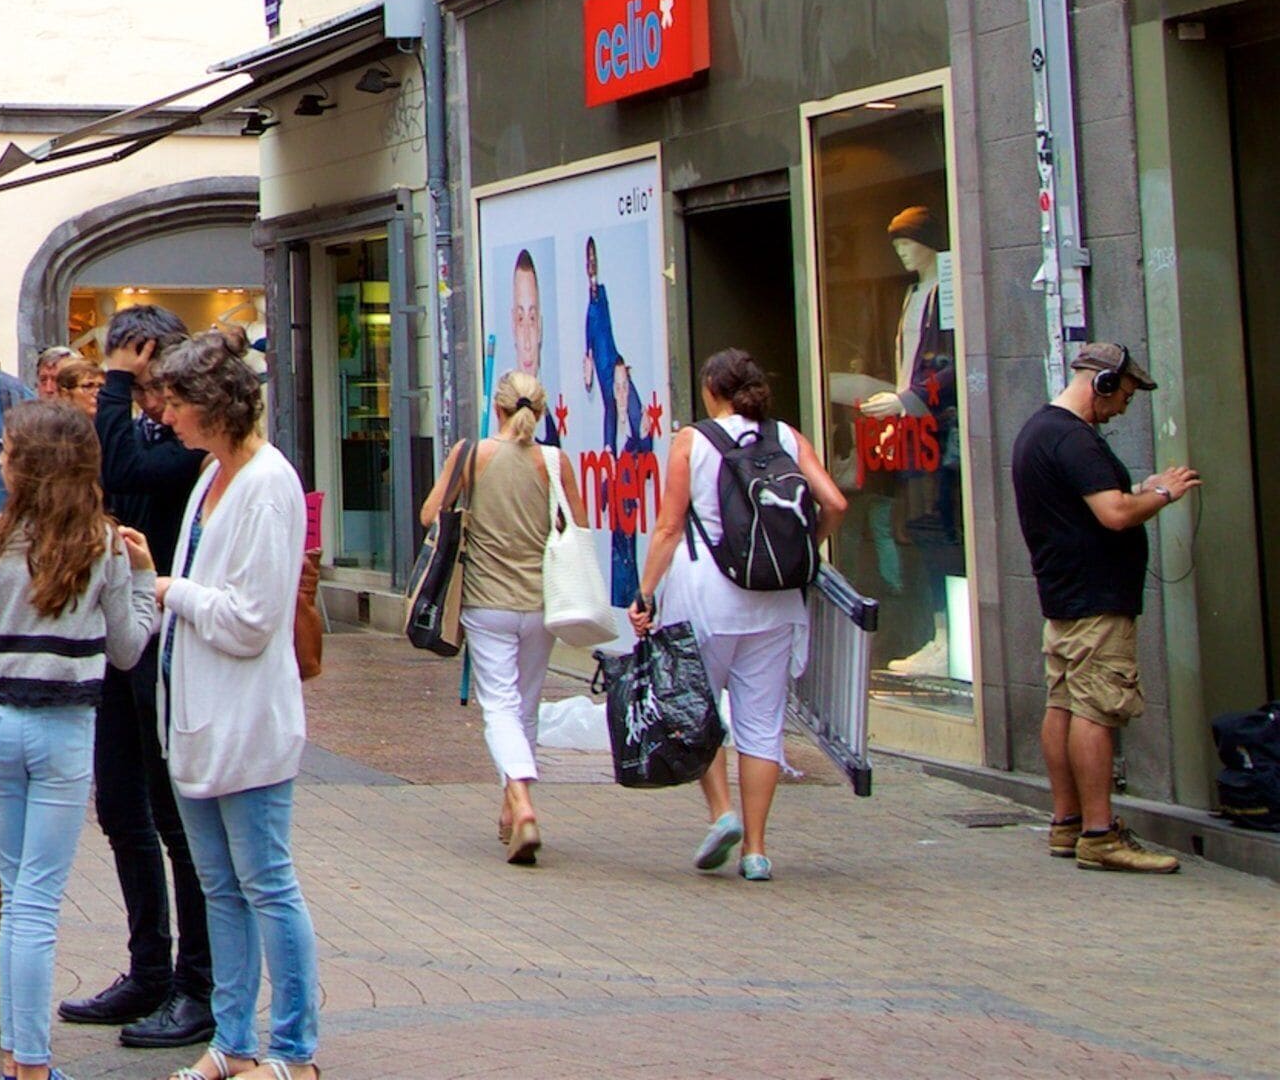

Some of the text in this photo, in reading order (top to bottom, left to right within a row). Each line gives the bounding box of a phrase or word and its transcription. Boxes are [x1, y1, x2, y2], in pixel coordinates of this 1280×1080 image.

[617, 186, 648, 217] celio
[854, 398, 940, 489] jeans
[579, 450, 662, 535] men
